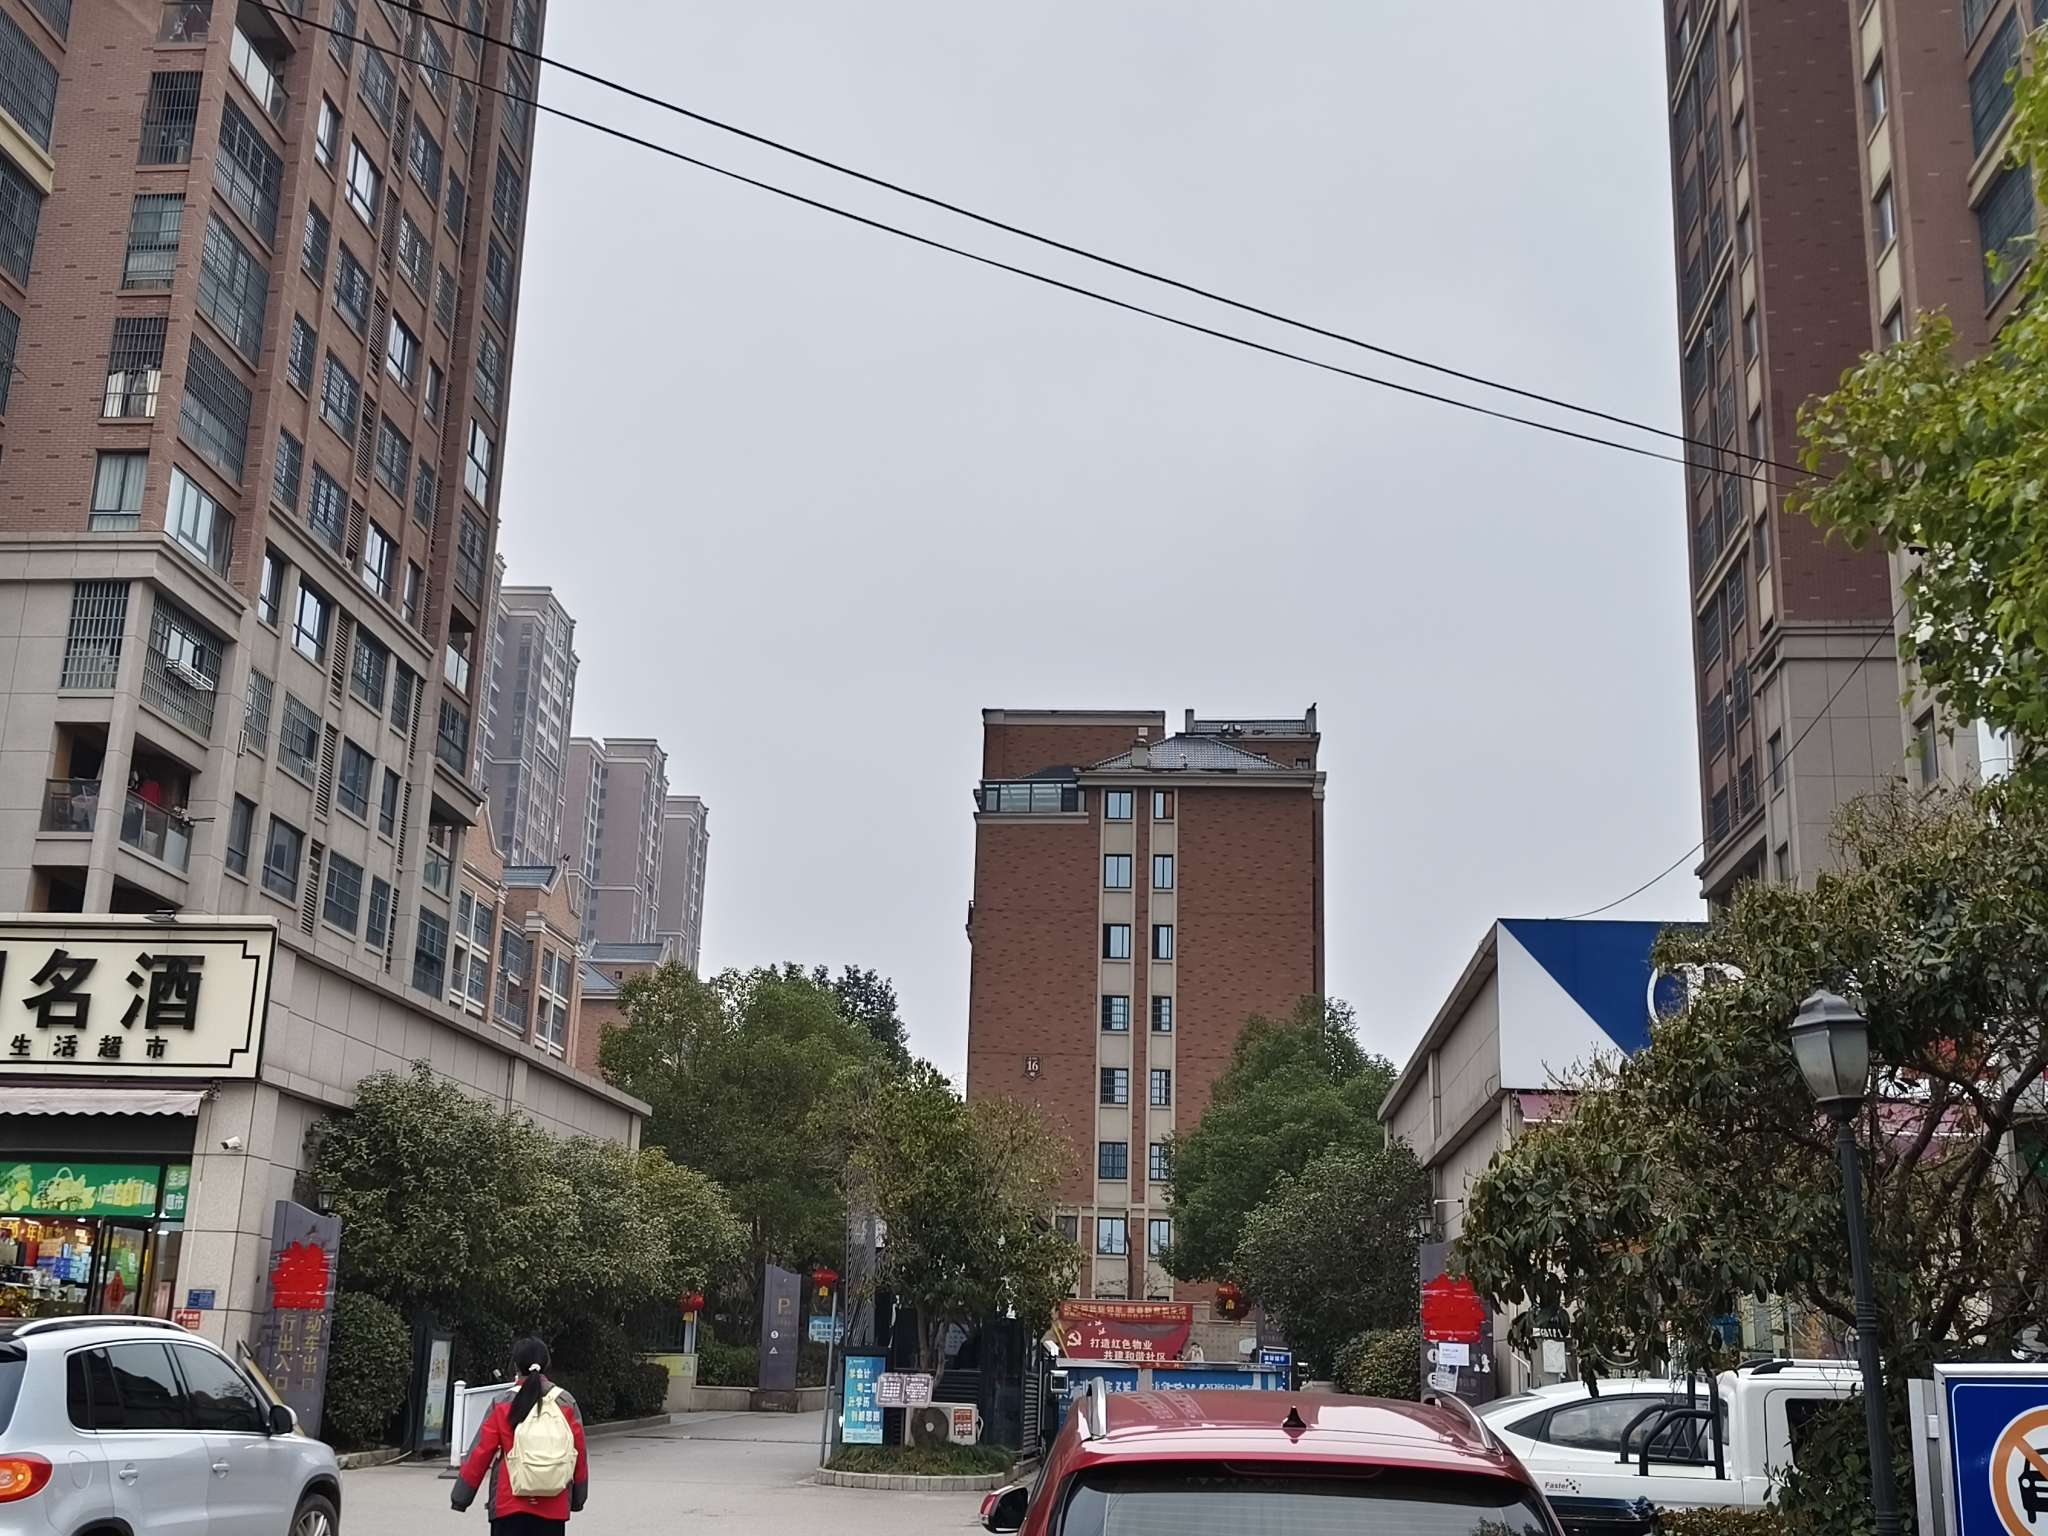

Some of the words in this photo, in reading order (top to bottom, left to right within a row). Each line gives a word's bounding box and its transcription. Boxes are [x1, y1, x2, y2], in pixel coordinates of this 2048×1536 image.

[0, 948, 205, 1031] 名酒
[9, 1033, 168, 1059] 生活超市
[1028, 1061, 1039, 1071] 16
[168, 1170, 188, 1186] 生活
[778, 1298, 790, 1314] P
[1090, 1338, 1153, 1350] 打造红色物业
[1103, 1350, 1166, 1361] 共建和谐社区
[1545, 1481, 1568, 1489] Faster
